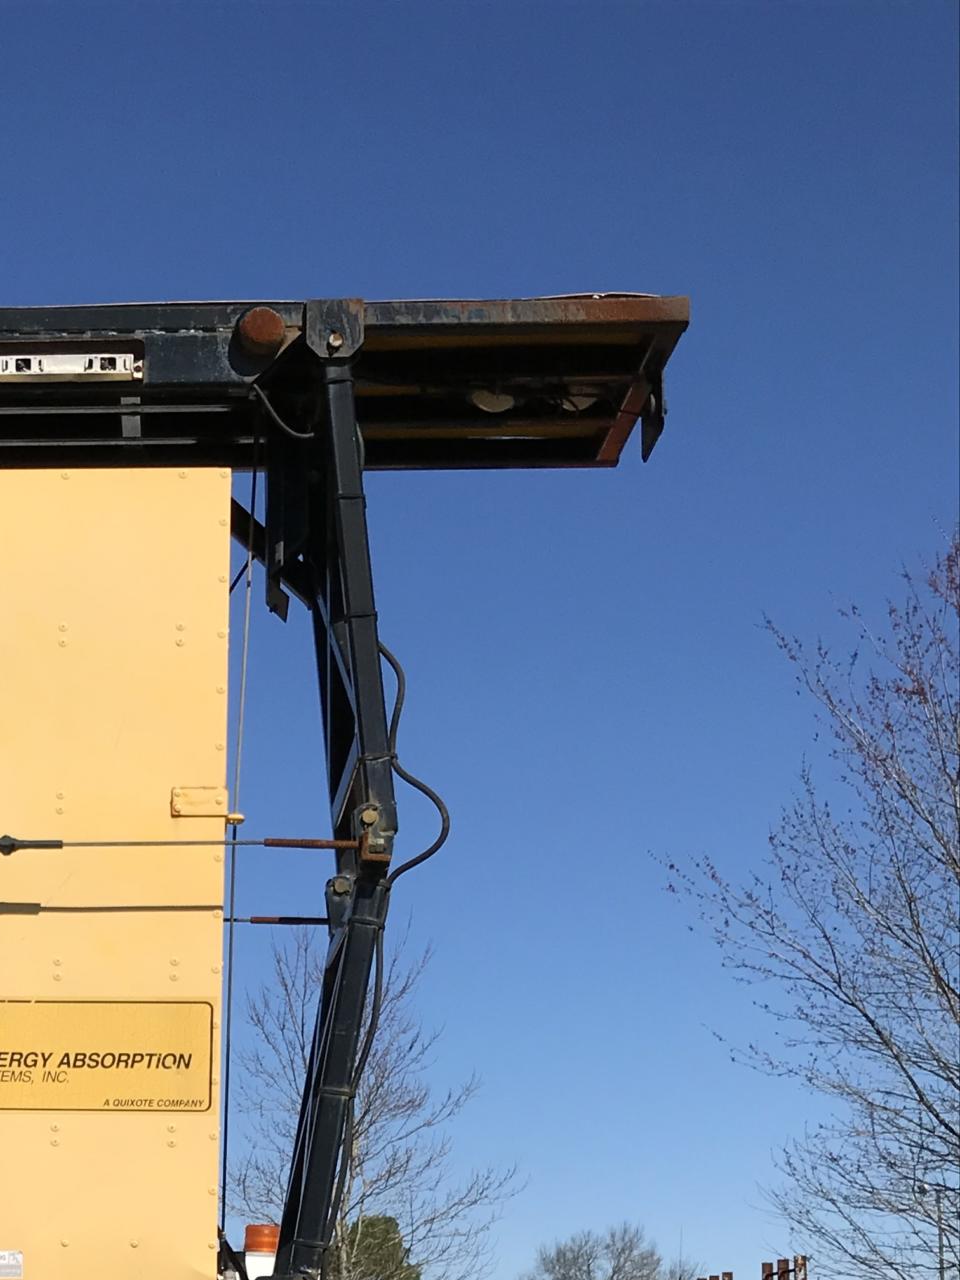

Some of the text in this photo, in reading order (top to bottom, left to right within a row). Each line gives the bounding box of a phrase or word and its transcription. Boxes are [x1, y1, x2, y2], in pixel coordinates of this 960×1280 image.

[57, 1052, 192, 1069] ABSORPTION
[42, 1071, 70, 1083] INC.
[103, 1098, 204, 1108] A QUIXOTE COMPANY
